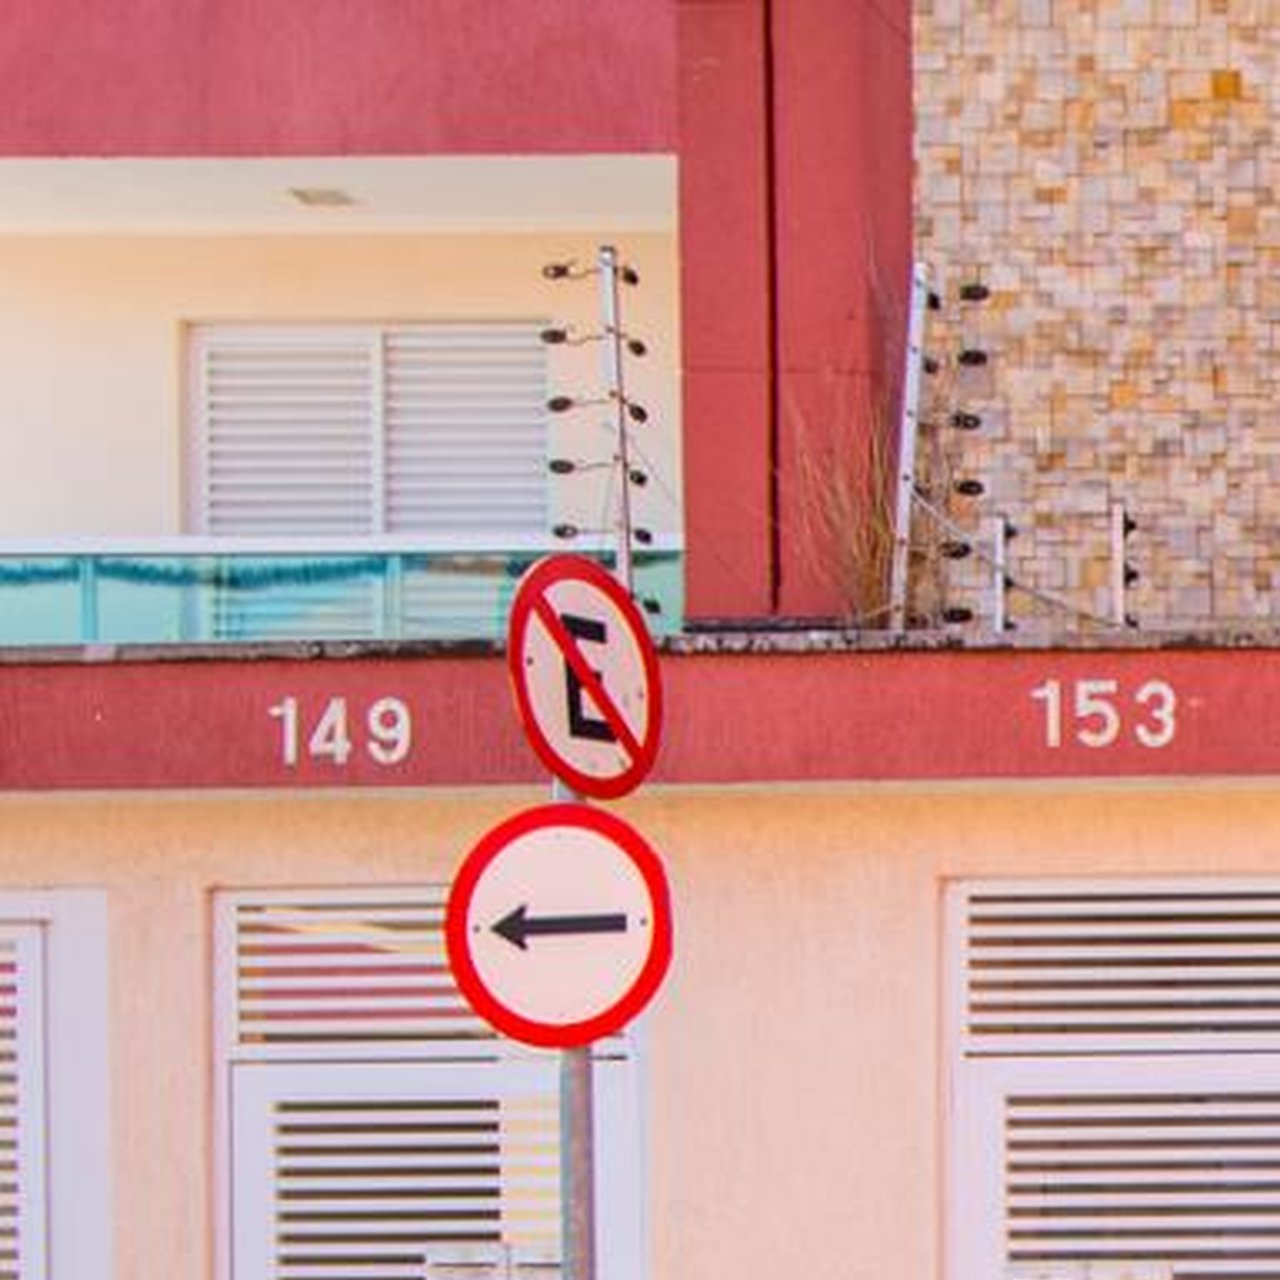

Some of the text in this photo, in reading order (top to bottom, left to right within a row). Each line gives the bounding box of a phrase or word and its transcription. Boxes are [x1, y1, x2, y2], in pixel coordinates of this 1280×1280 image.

[561, 613, 620, 744] E
[268, 697, 412, 766] 149
[1031, 679, 1176, 748] 153
